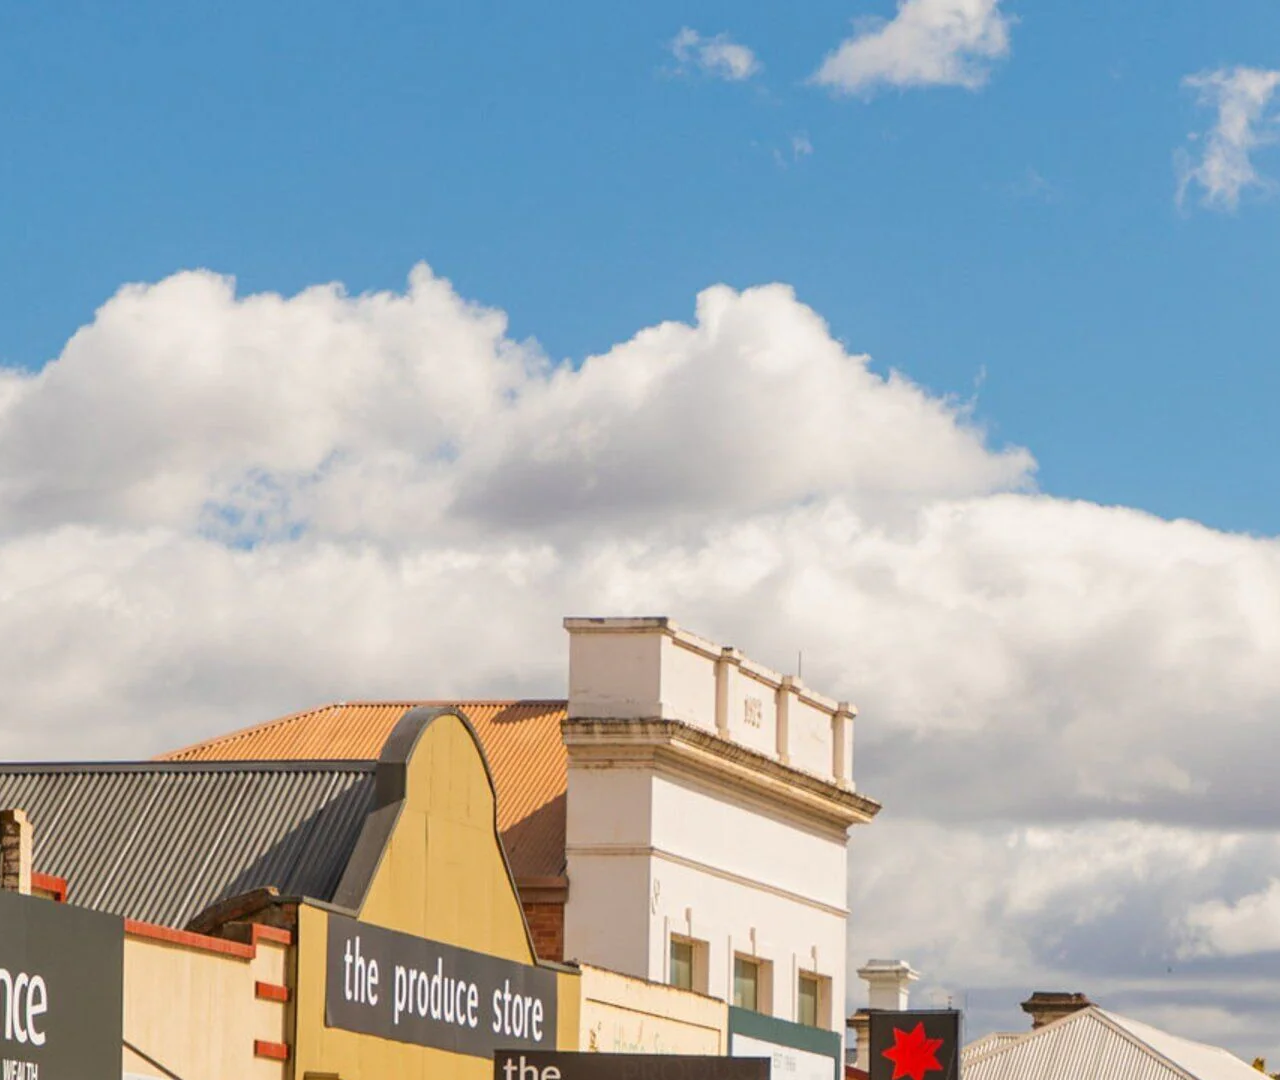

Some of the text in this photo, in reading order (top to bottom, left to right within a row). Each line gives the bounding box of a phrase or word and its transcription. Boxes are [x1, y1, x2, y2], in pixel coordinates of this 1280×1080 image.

[343, 935, 379, 1005] the
[393, 956, 479, 1029] produce
[492, 978, 544, 1042] store
